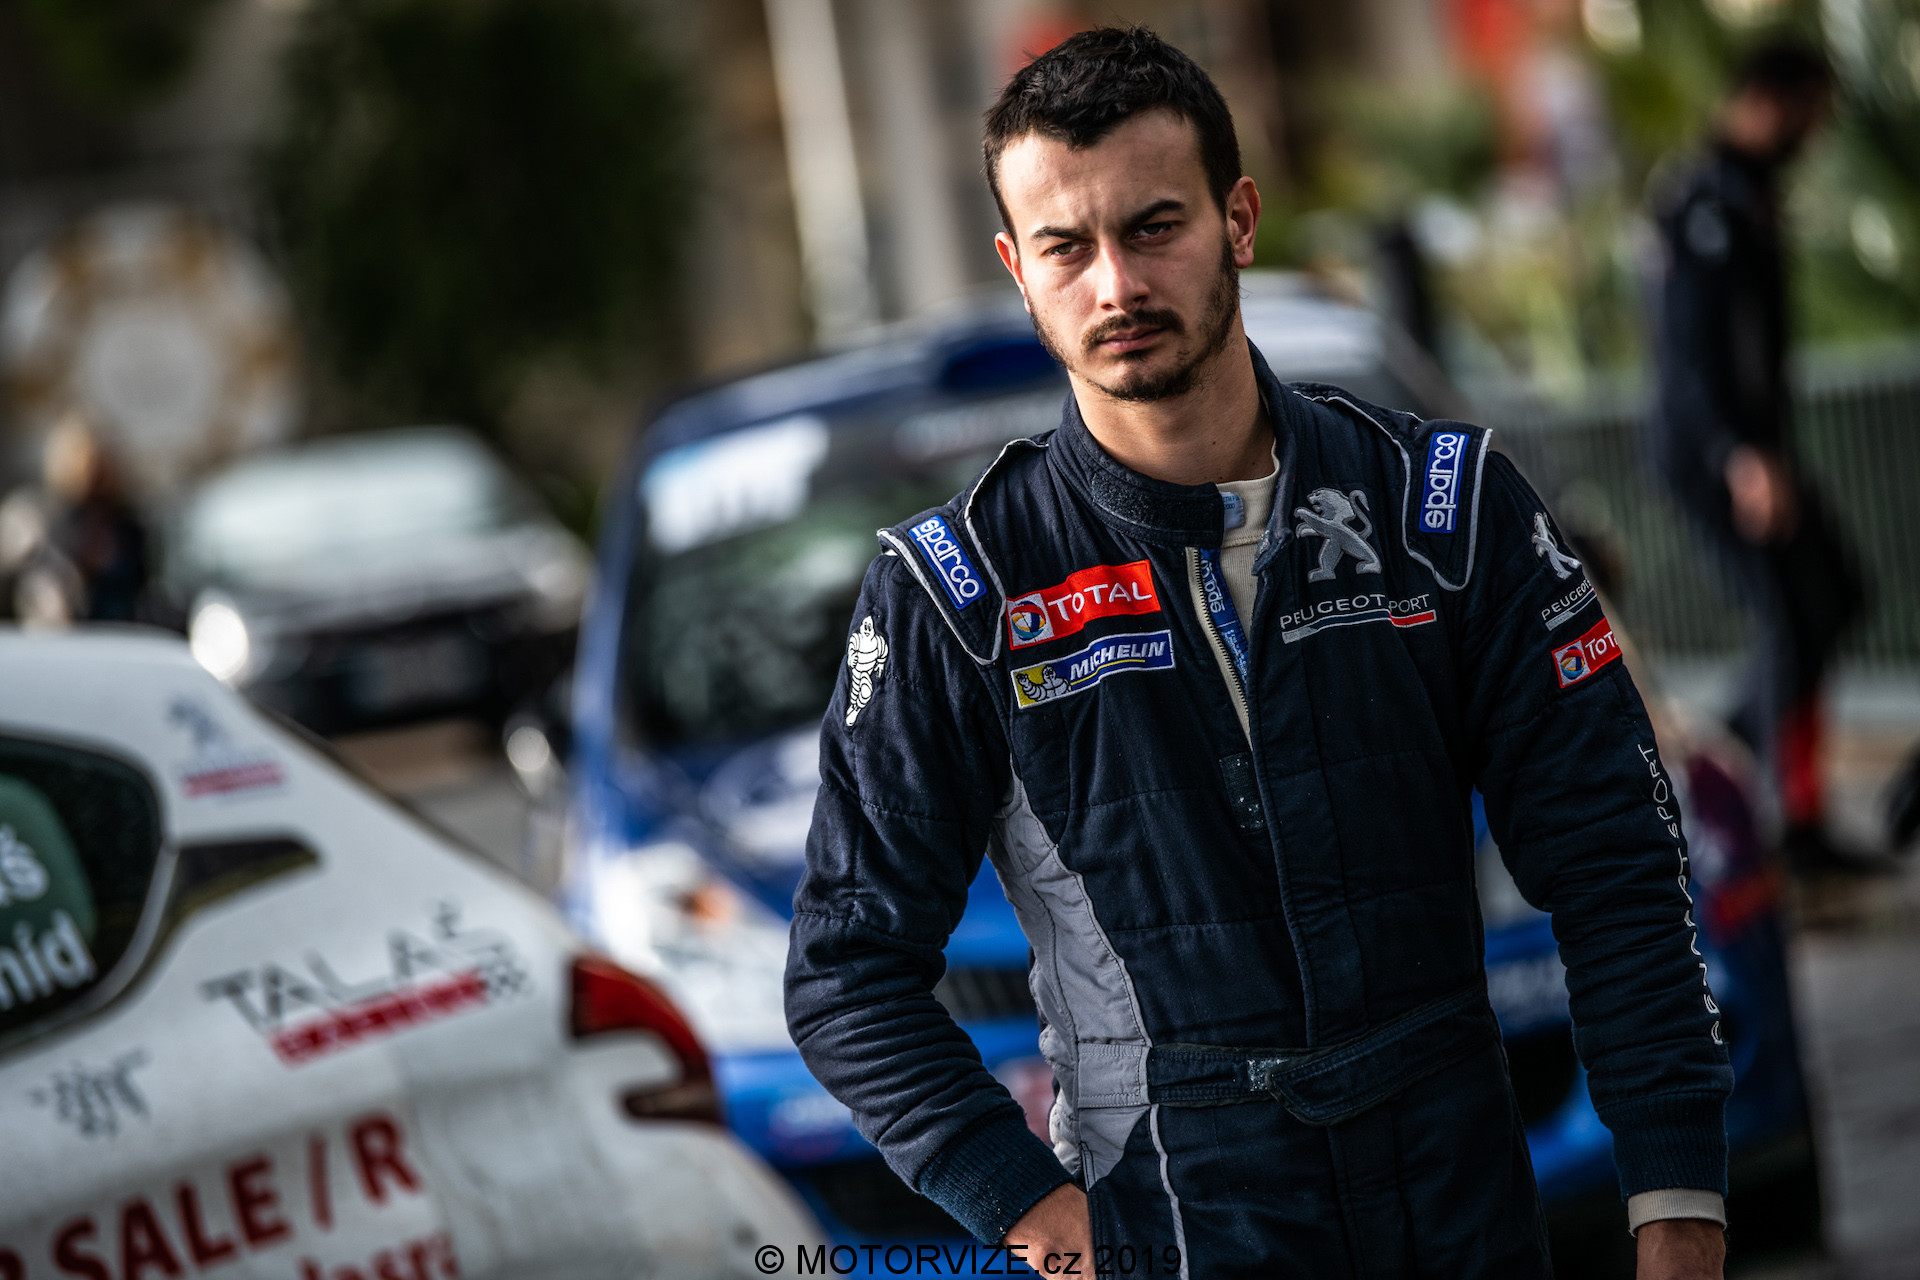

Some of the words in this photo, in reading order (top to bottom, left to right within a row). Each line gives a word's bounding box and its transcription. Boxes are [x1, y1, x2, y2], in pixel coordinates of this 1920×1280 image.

[1425, 434, 1459, 529] sparco
[915, 519, 979, 601] sparco
[1047, 581, 1152, 621] TOTAL
[1279, 593, 1386, 629] PEUGEOT
[1388, 593, 1430, 613] PORT
[1070, 640, 1168, 680] MICHELIN
[1584, 631, 1618, 660] TOT
[52, 1150, 292, 1280] SALE
